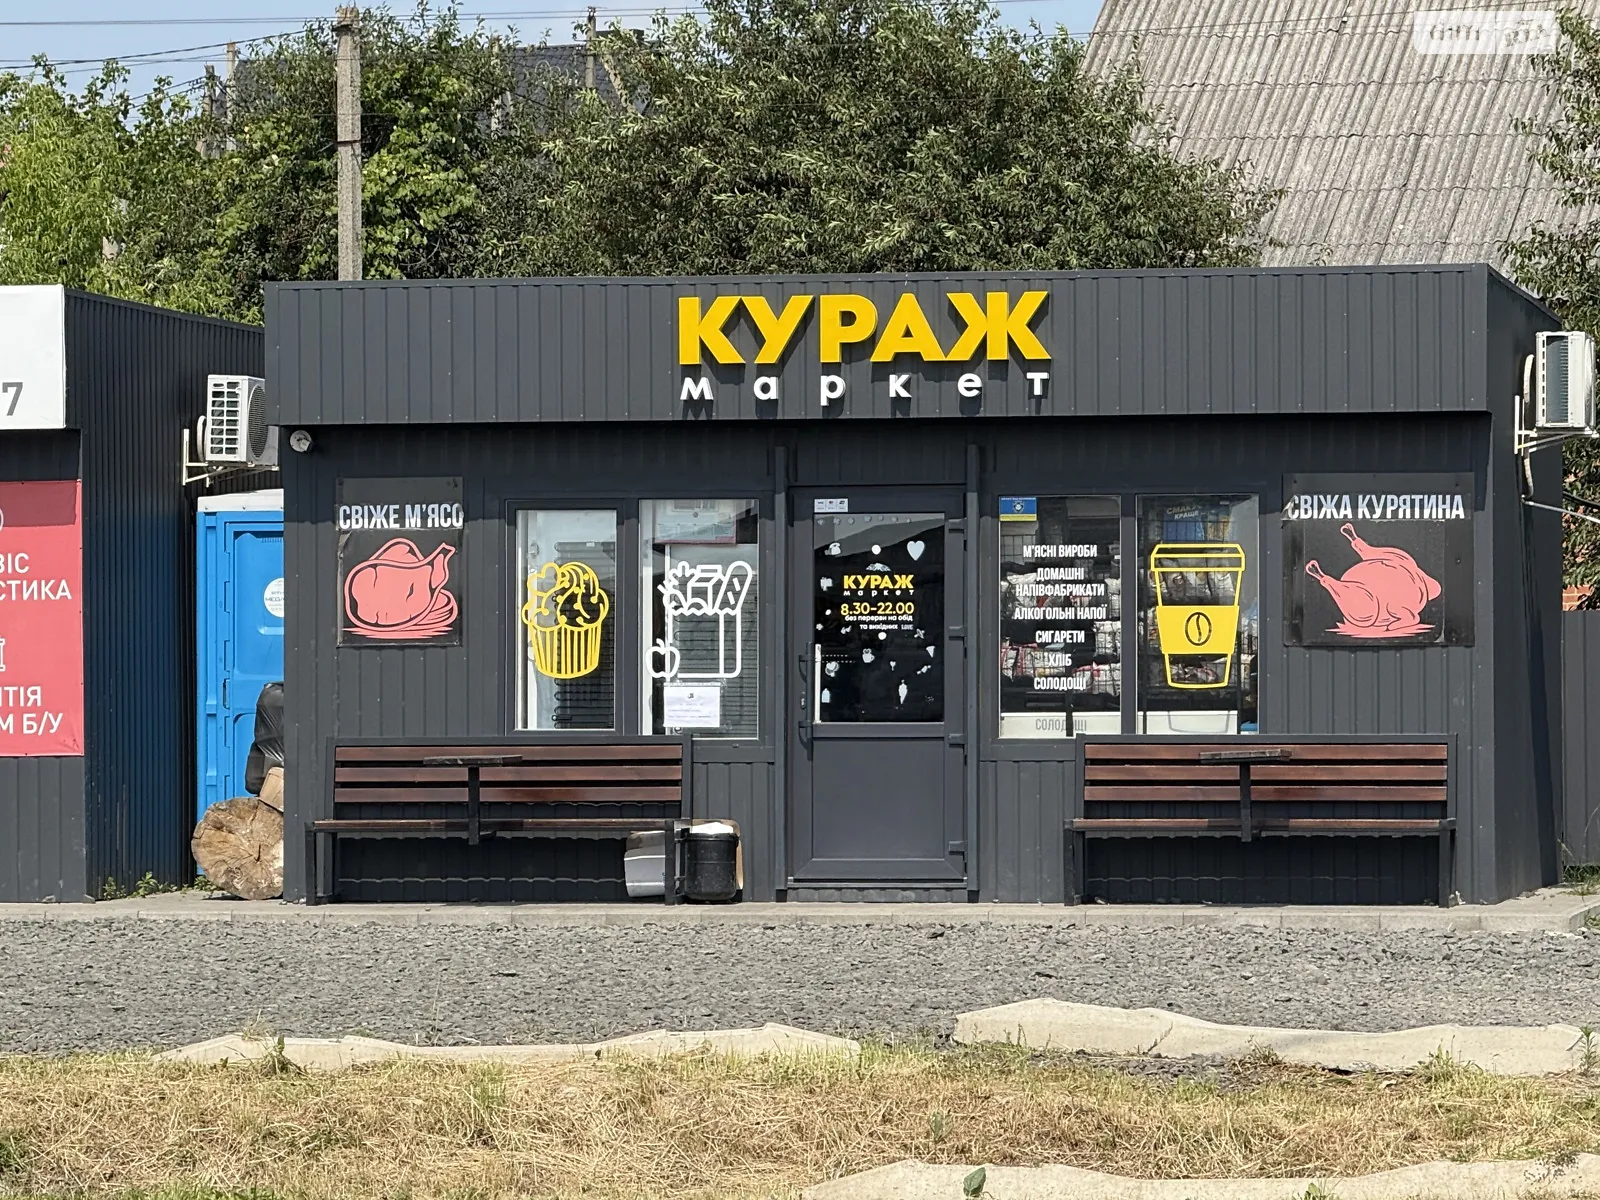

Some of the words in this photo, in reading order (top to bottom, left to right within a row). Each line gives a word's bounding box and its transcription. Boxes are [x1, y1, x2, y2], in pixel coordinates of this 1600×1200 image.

[678, 291, 1051, 365] КУРАЖ
[680, 372, 1050, 406] маркет
[2, 381, 23, 416] 7
[1287, 494, 1353, 519] СВІЖА
[1357, 494, 1465, 519] КУРЯТИНА
[339, 504, 400, 529] СВІЖЕ
[1023, 544, 1057, 558] М'ЯСНІ
[1058, 544, 1098, 558] ВИРОБИ
[1036, 567, 1085, 581] ДОМАШНІ
[843, 574, 914, 589] КУРАЖ
[1015, 583, 1105, 597] НАПІВФАБРИКАТИ
[840, 602, 914, 615] 8.30-22.00
[1013, 606, 1075, 620] АЛКОГОЛЬНІ
[1076, 603, 1108, 620] НАПОЇ
[844, 614, 857, 622] без
[897, 614, 913, 622] обід
[868, 622, 899, 630] вихідних
[1035, 630, 1085, 643] СИГАРЕТИ
[1048, 653, 1072, 667] ХЛІБ
[1033, 677, 1087, 691] СОЛОДОЩІ
[0, 685, 42, 708] ТІЯ
[22, 711, 64, 736] Б/У
